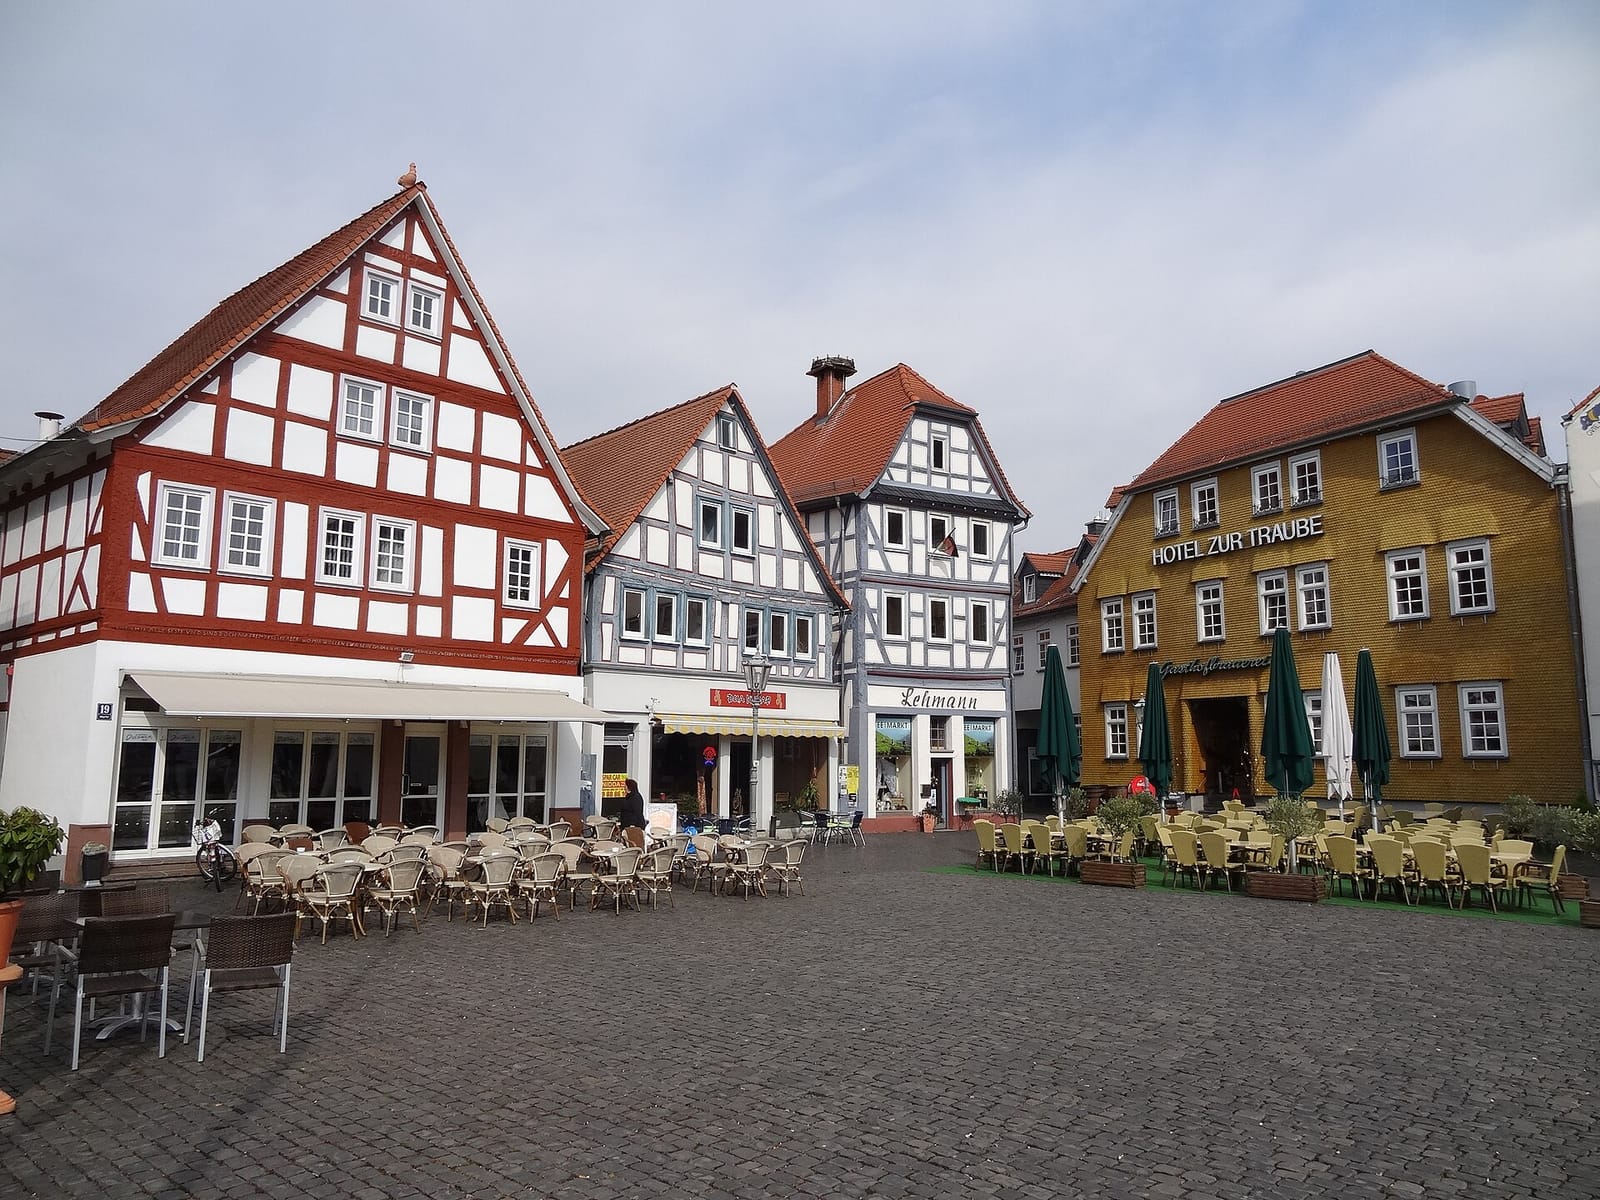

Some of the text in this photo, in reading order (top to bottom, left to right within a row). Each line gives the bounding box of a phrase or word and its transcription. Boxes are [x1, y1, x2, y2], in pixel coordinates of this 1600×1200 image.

[1152, 514, 1324, 566] HOTEL ZUR TRAUBE
[100, 704, 110, 714] 19
[901, 687, 978, 710] Lehmann
